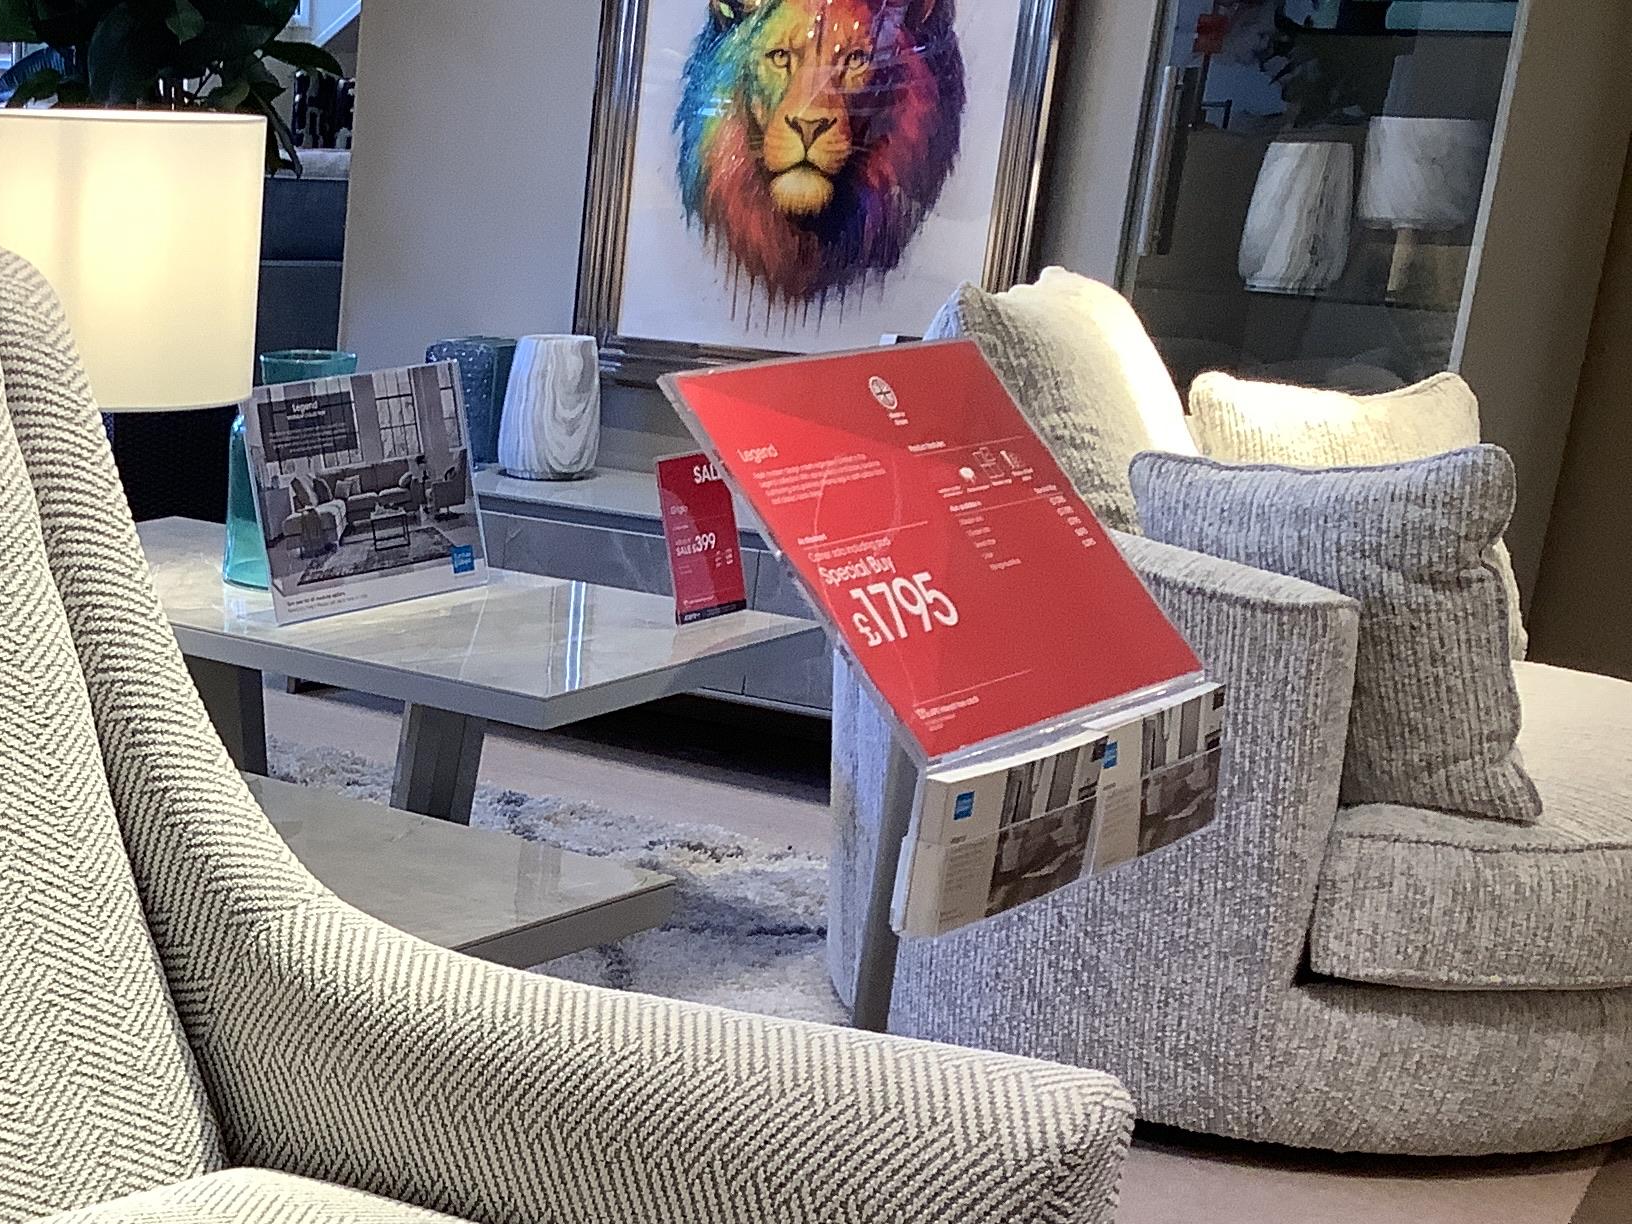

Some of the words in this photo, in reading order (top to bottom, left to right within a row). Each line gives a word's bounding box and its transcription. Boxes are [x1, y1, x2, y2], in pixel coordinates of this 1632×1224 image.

[737, 443, 778, 464] Legend
[818, 557, 870, 587] Special
[866, 555, 896, 574] Buy
[849, 571, 958, 647] £1795
